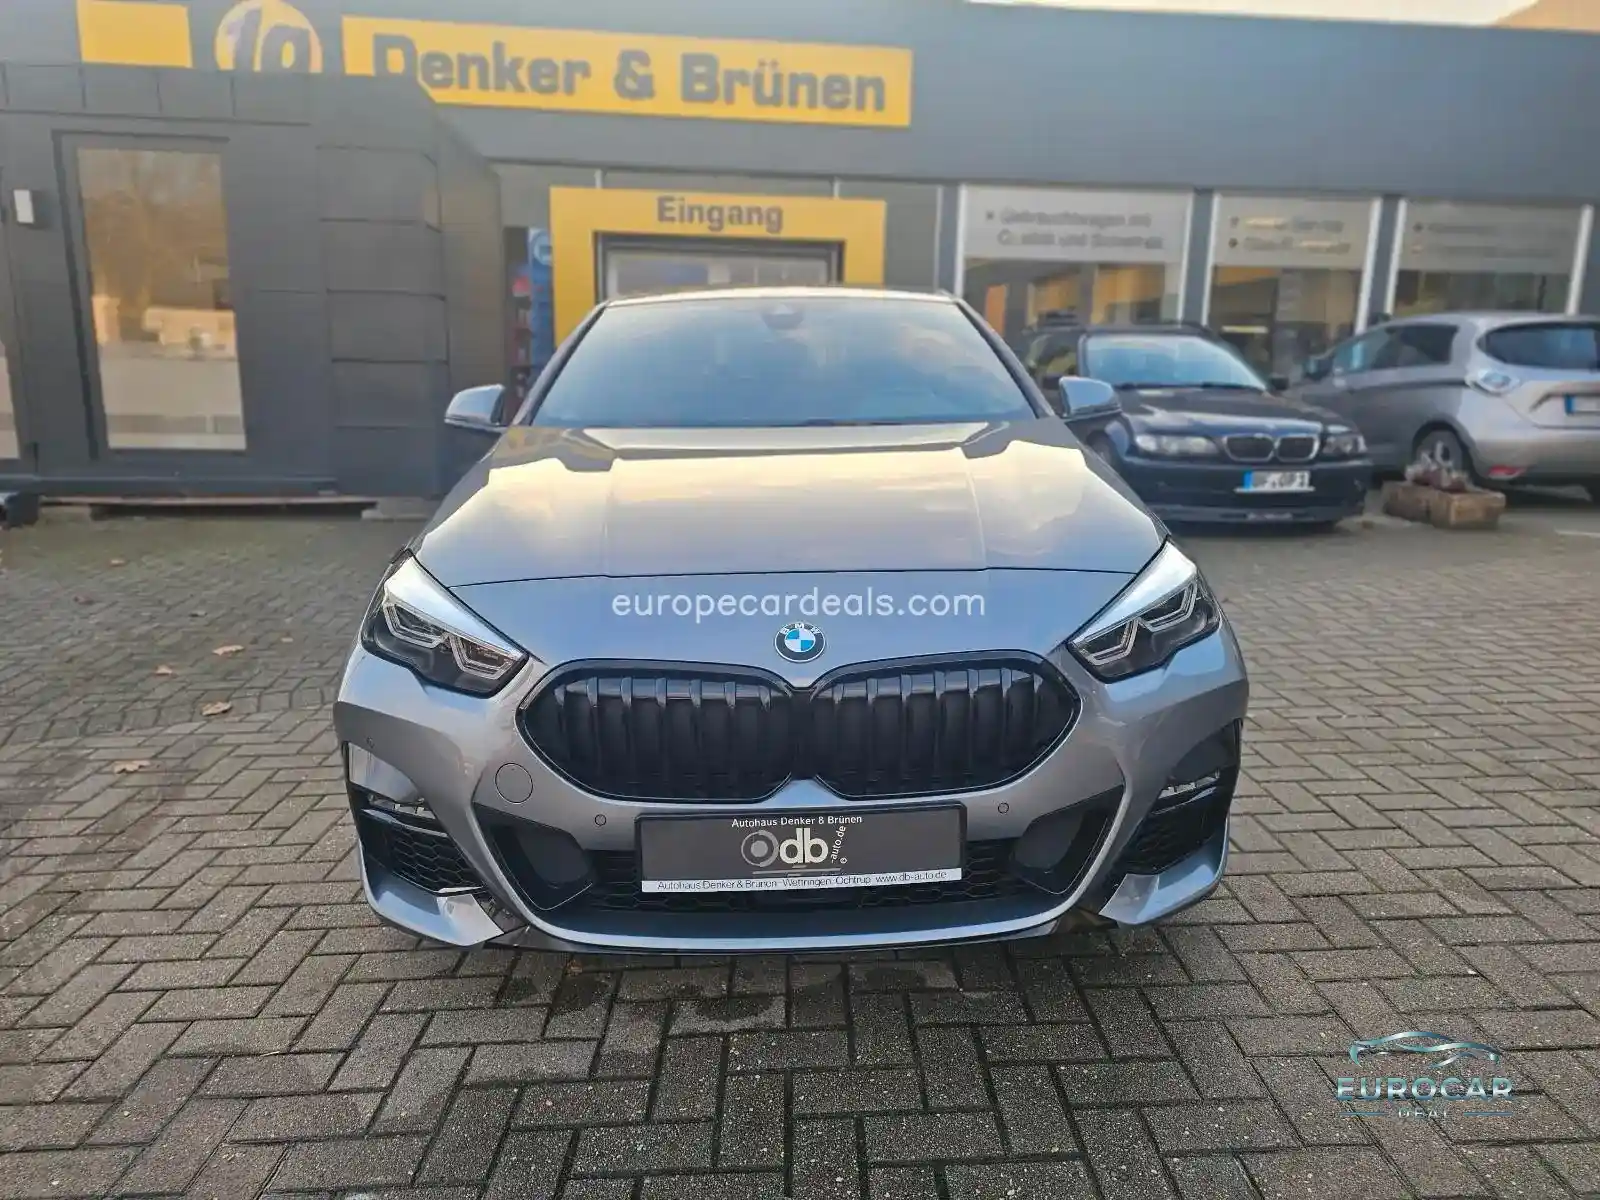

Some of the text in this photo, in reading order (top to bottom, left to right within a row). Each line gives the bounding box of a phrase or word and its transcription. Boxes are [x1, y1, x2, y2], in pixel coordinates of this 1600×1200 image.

[373, 34, 886, 112] Denker & Brünen
[656, 195, 784, 233] Eingang
[731, 818, 778, 828] Autohaus
[780, 817, 816, 826] Denker
[827, 815, 863, 825] Brünen
[657, 880, 702, 891] Autohaus
[702, 879, 735, 890] Denker
[736, 879, 743, 889] &
[782, 877, 832, 889] Wettringen
[835, 875, 872, 887] Ochtrup
[875, 870, 948, 884] www.db-auto.de
